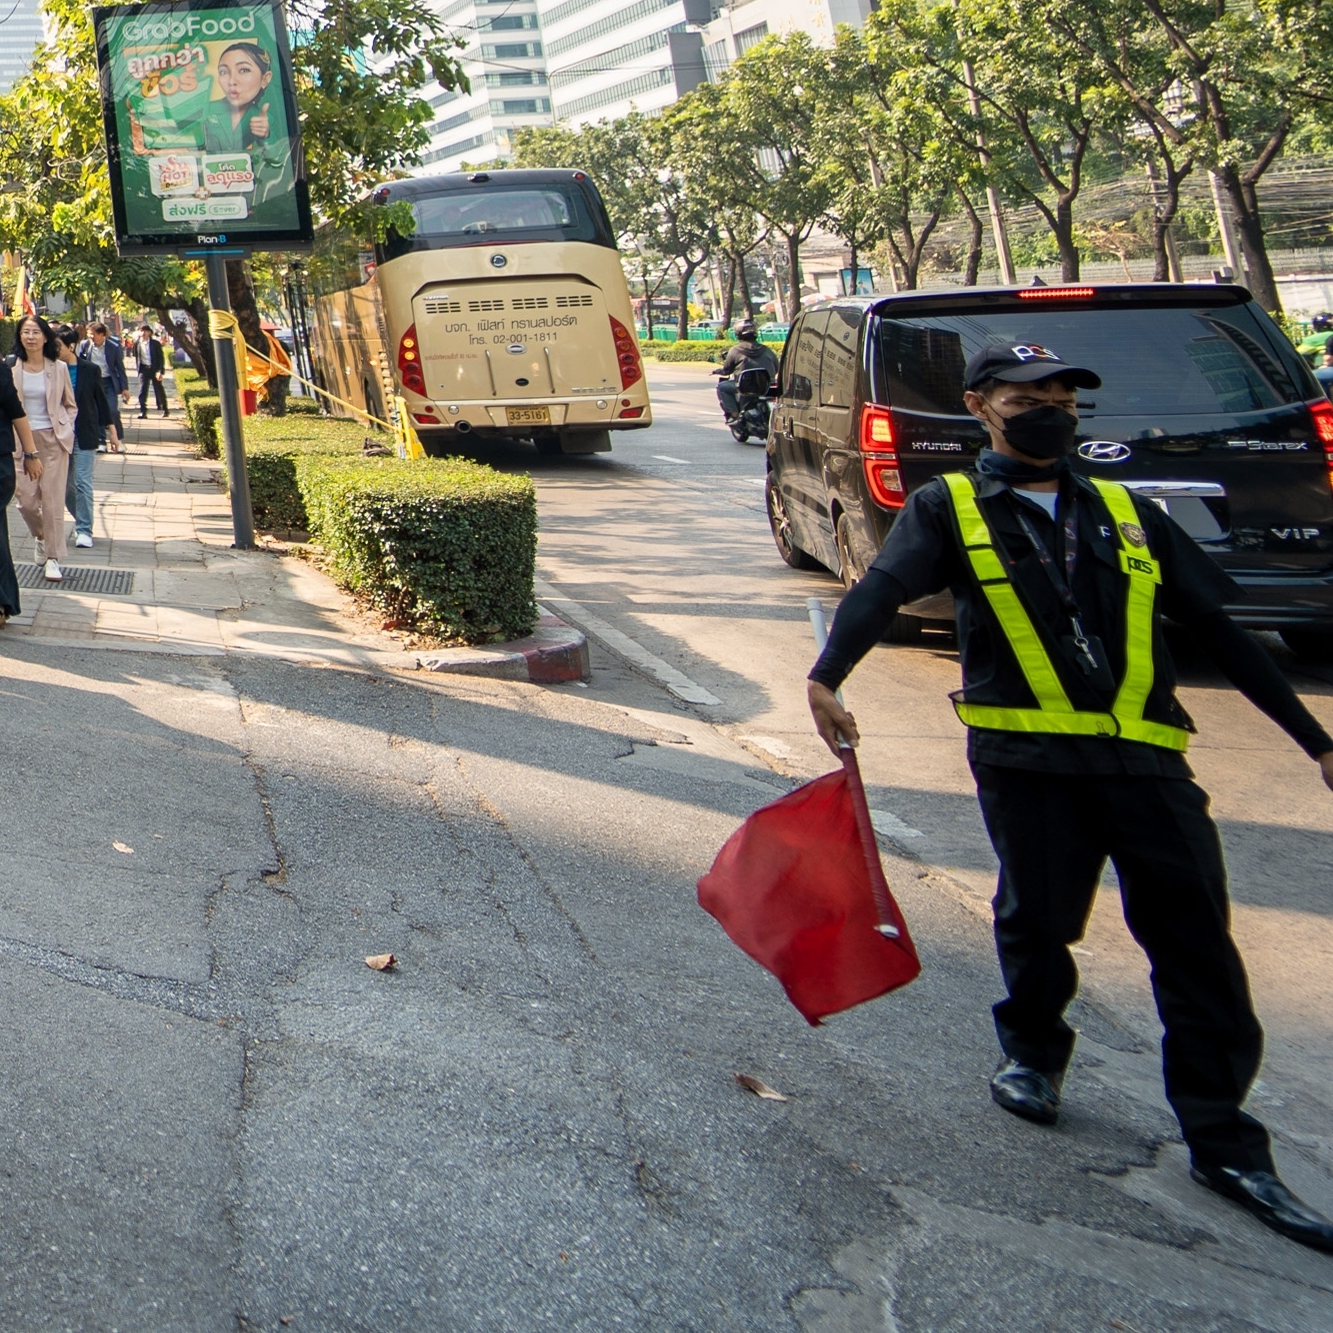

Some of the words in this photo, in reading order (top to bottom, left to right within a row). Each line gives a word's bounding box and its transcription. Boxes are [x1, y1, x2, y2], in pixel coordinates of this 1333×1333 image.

[122, 12, 255, 40] GrabFood
[127, 43, 205, 79] ถูกกว่า
[163, 171, 188, 182] HOT
[169, 203, 207, 216] ส่งฟรี
[445, 323, 470, 333] บจก.
[469, 334, 487, 345] โทร.
[493, 332, 558, 344] 02-001-1811
[912, 442, 961, 451] HYUNDAI
[1247, 440, 1308, 451] Starex
[1271, 528, 1320, 540] VIP
